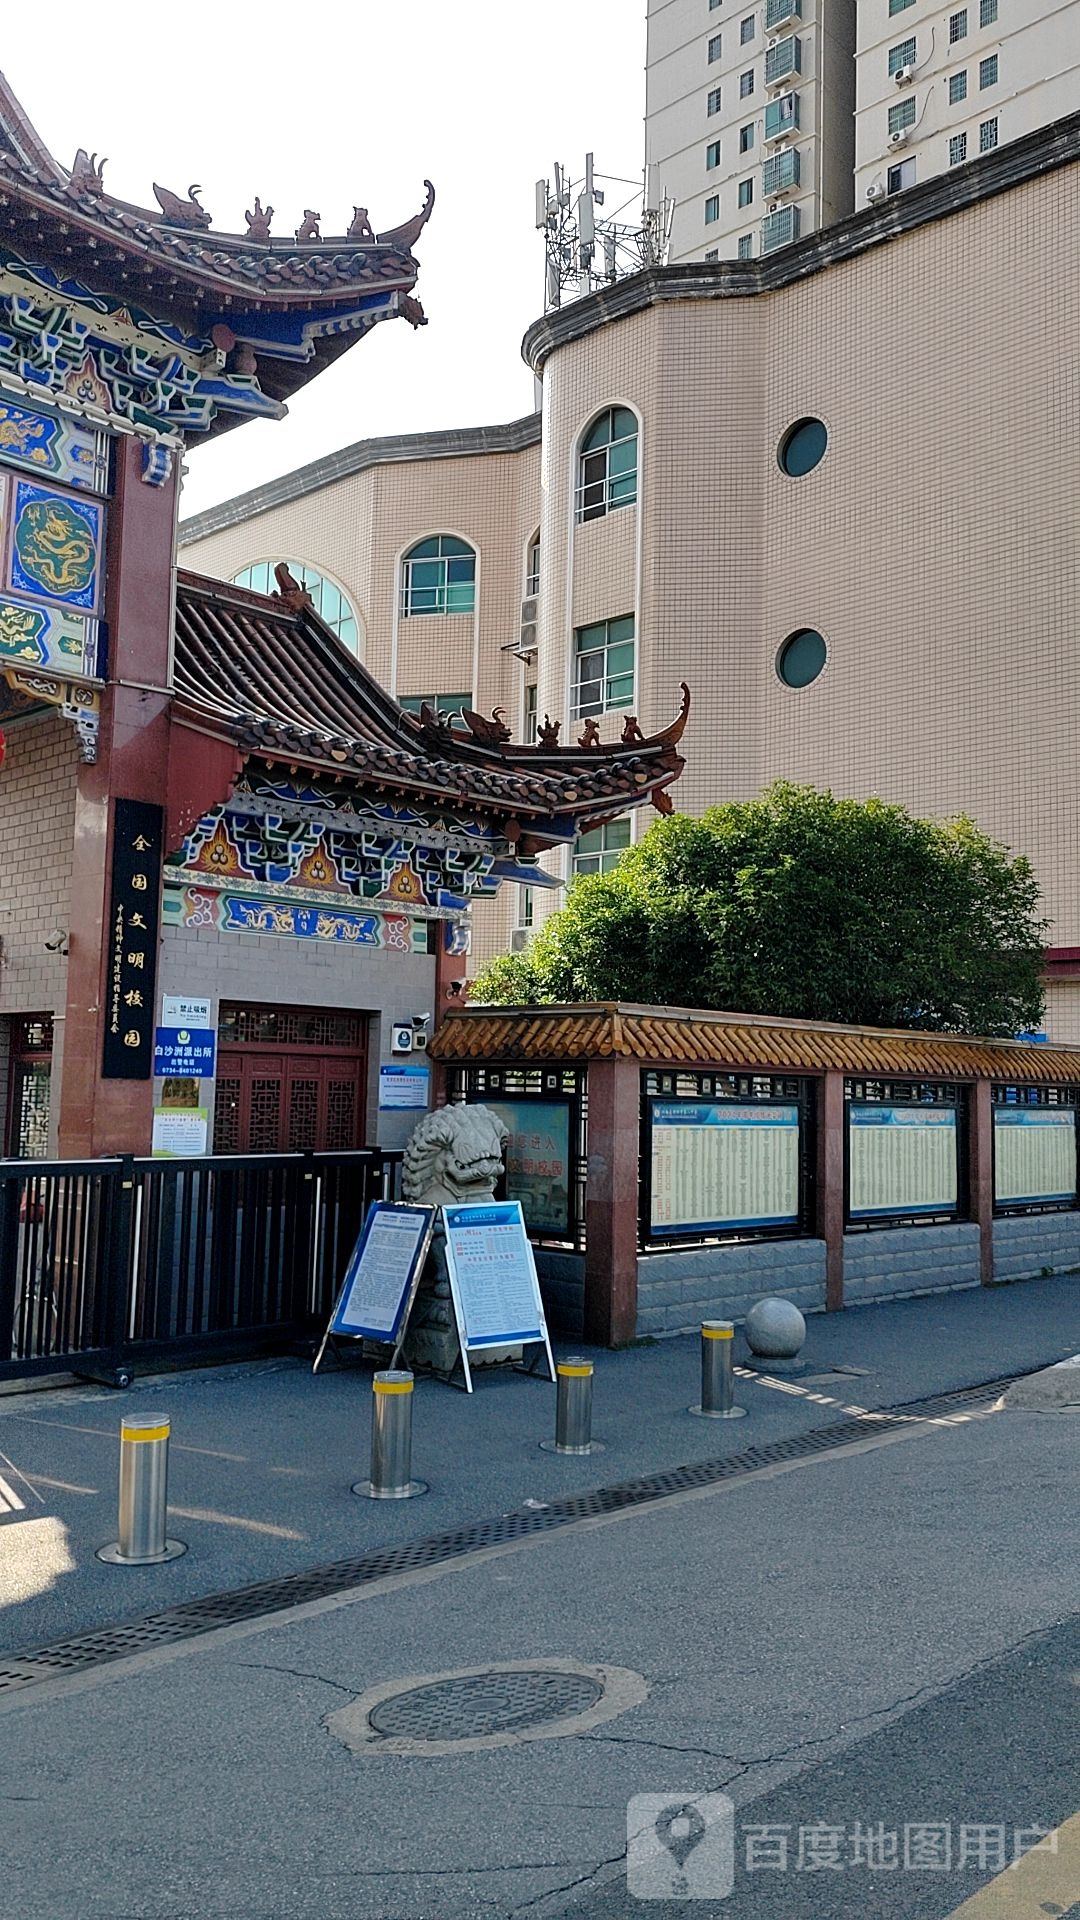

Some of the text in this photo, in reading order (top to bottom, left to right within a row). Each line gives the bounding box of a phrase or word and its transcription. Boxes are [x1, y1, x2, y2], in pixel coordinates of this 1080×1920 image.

[124, 834, 152, 1047] 全国文明校园
[180, 1004, 207, 1014] 禁止吸烟
[154, 1045, 212, 1058] 白沙洲派出所
